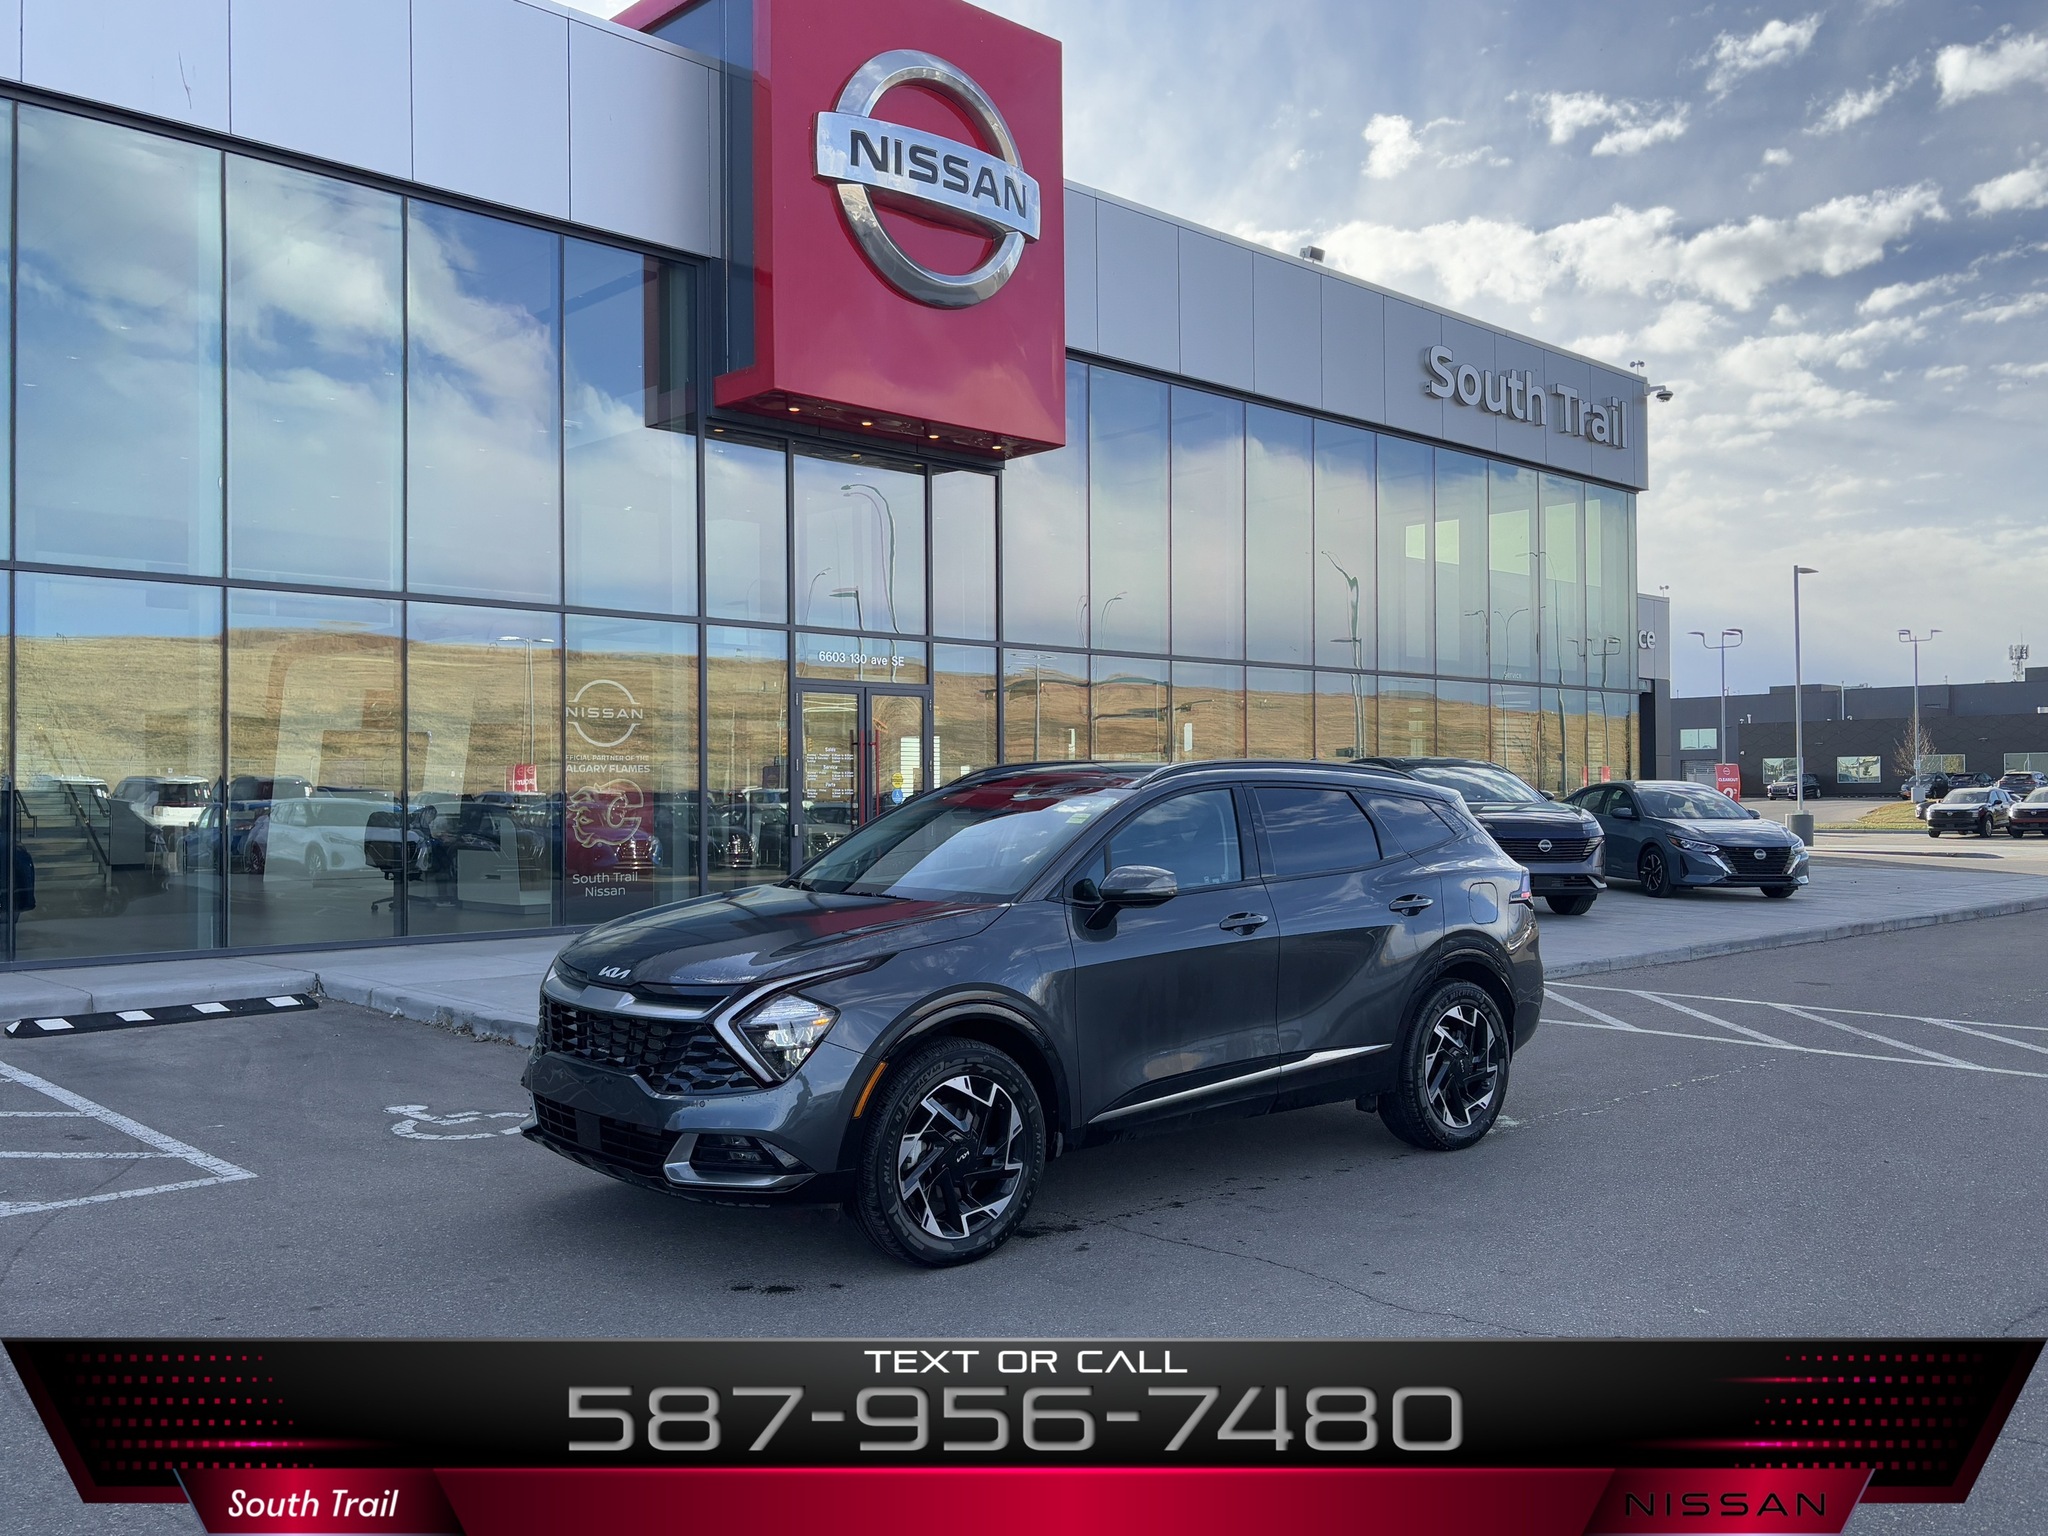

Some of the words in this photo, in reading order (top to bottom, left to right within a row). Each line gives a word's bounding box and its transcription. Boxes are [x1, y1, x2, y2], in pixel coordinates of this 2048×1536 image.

[850, 129, 1027, 219] NISSAN
[1425, 345, 1547, 427] South
[1552, 382, 1629, 449] Trail
[818, 650, 846, 663] 6603
[849, 653, 867, 664] 130
[870, 656, 888, 666] ave
[891, 655, 905, 667] SE
[565, 706, 644, 720] NISSAN
[592, 754, 624, 762] PARTNER
[609, 764, 651, 773] FLAMES
[572, 873, 610, 885] South
[613, 871, 638, 882] Trail
[585, 886, 626, 897] Nissan
